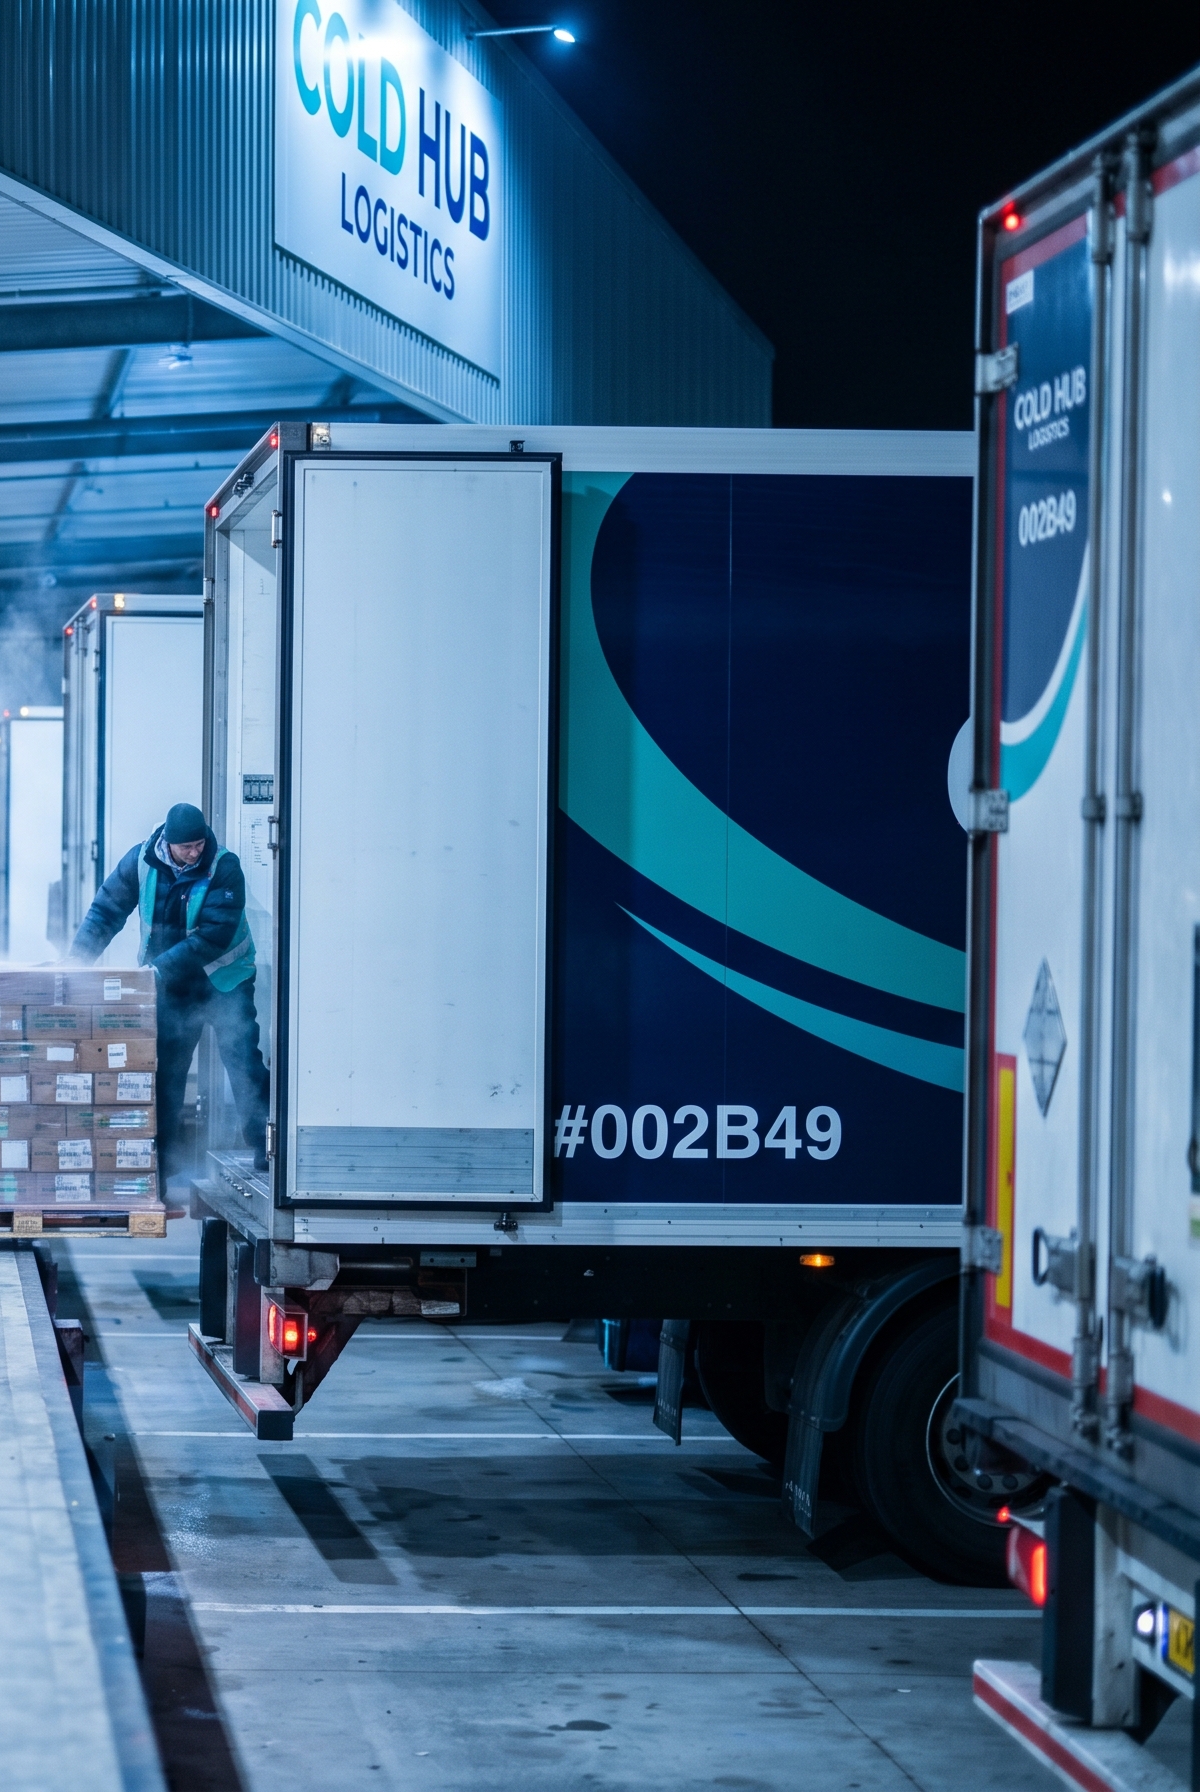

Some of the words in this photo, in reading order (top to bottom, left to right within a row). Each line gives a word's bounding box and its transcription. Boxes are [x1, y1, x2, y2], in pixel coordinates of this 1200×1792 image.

[293, 0, 406, 175] COLD
[419, 87, 490, 241] HUB
[341, 172, 455, 300] LOGISTICS
[1014, 381, 1052, 431] COLD
[1054, 365, 1086, 414] HUB
[1018, 489, 1077, 547] 002B49
[554, 1104, 842, 1160] #002B49
